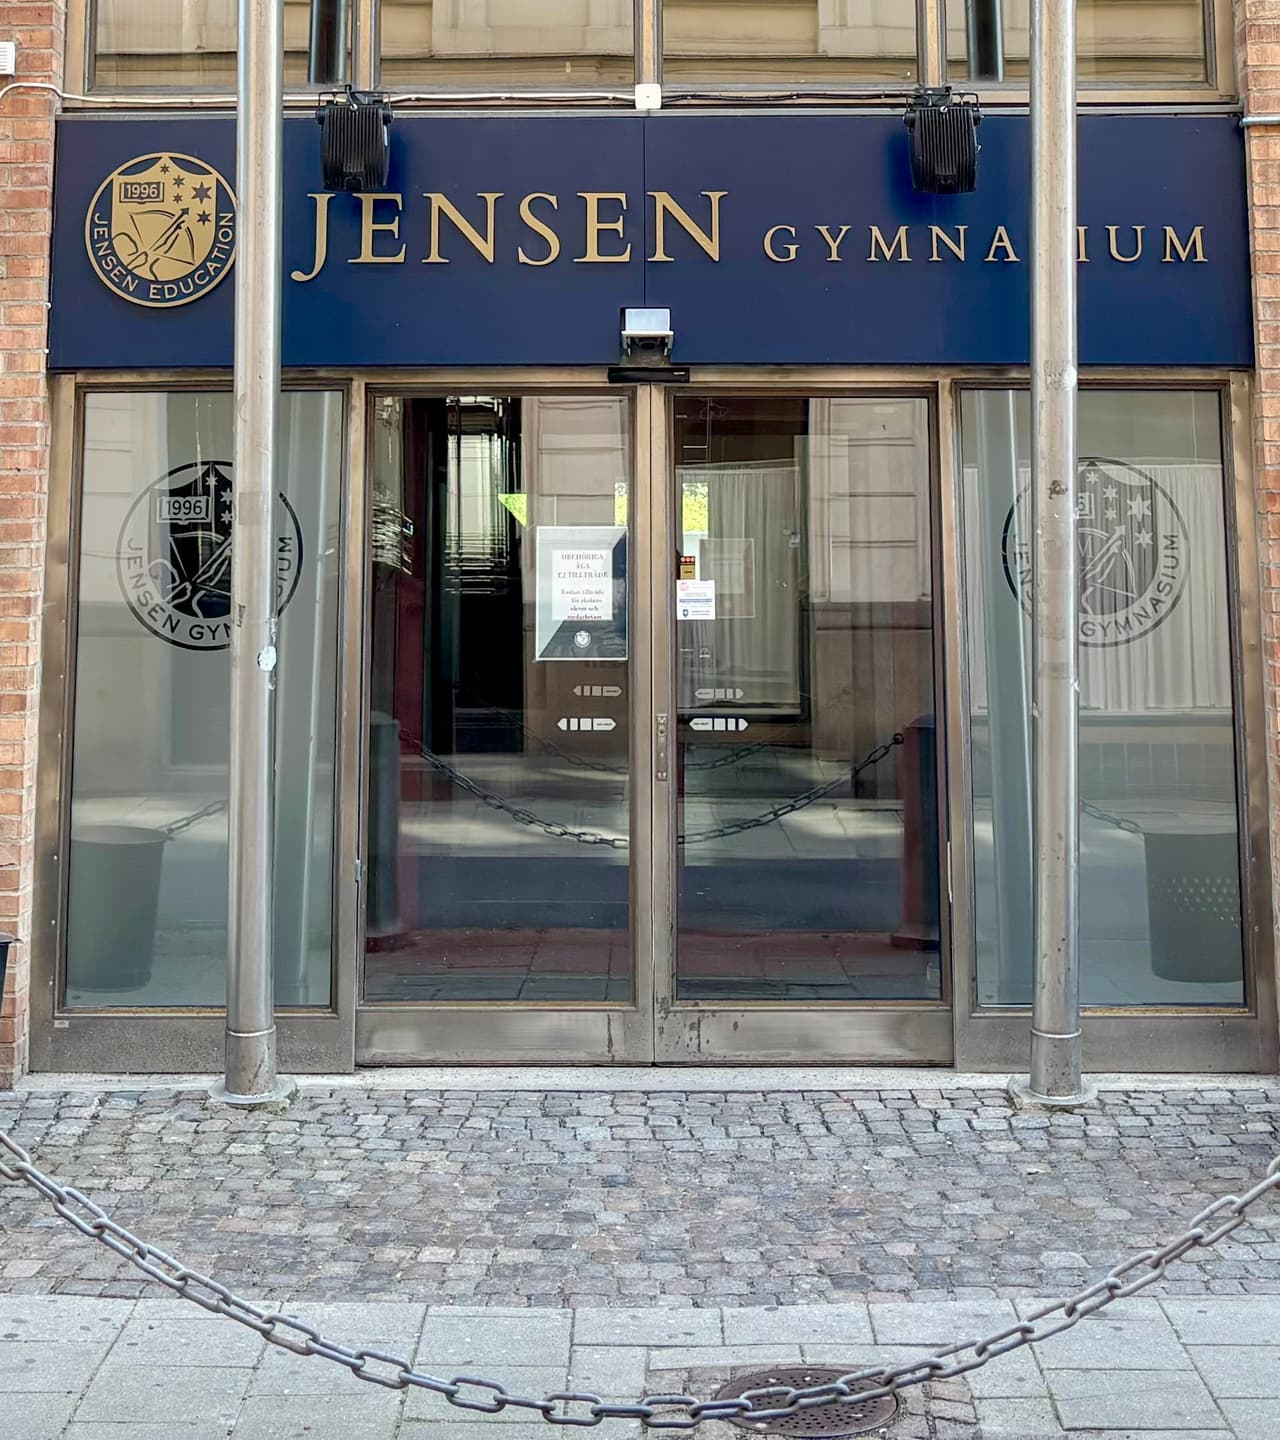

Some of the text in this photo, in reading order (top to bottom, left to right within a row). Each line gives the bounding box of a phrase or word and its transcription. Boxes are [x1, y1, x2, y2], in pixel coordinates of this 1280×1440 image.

[125, 183, 159, 199] 1996
[94, 212, 234, 300] JENSEN EDUCATION
[290, 192, 1209, 282] JENSEN GYMNAIUM
[127, 537, 181, 635] JENSEN
[1079, 533, 1180, 638] GYMNASIUM
